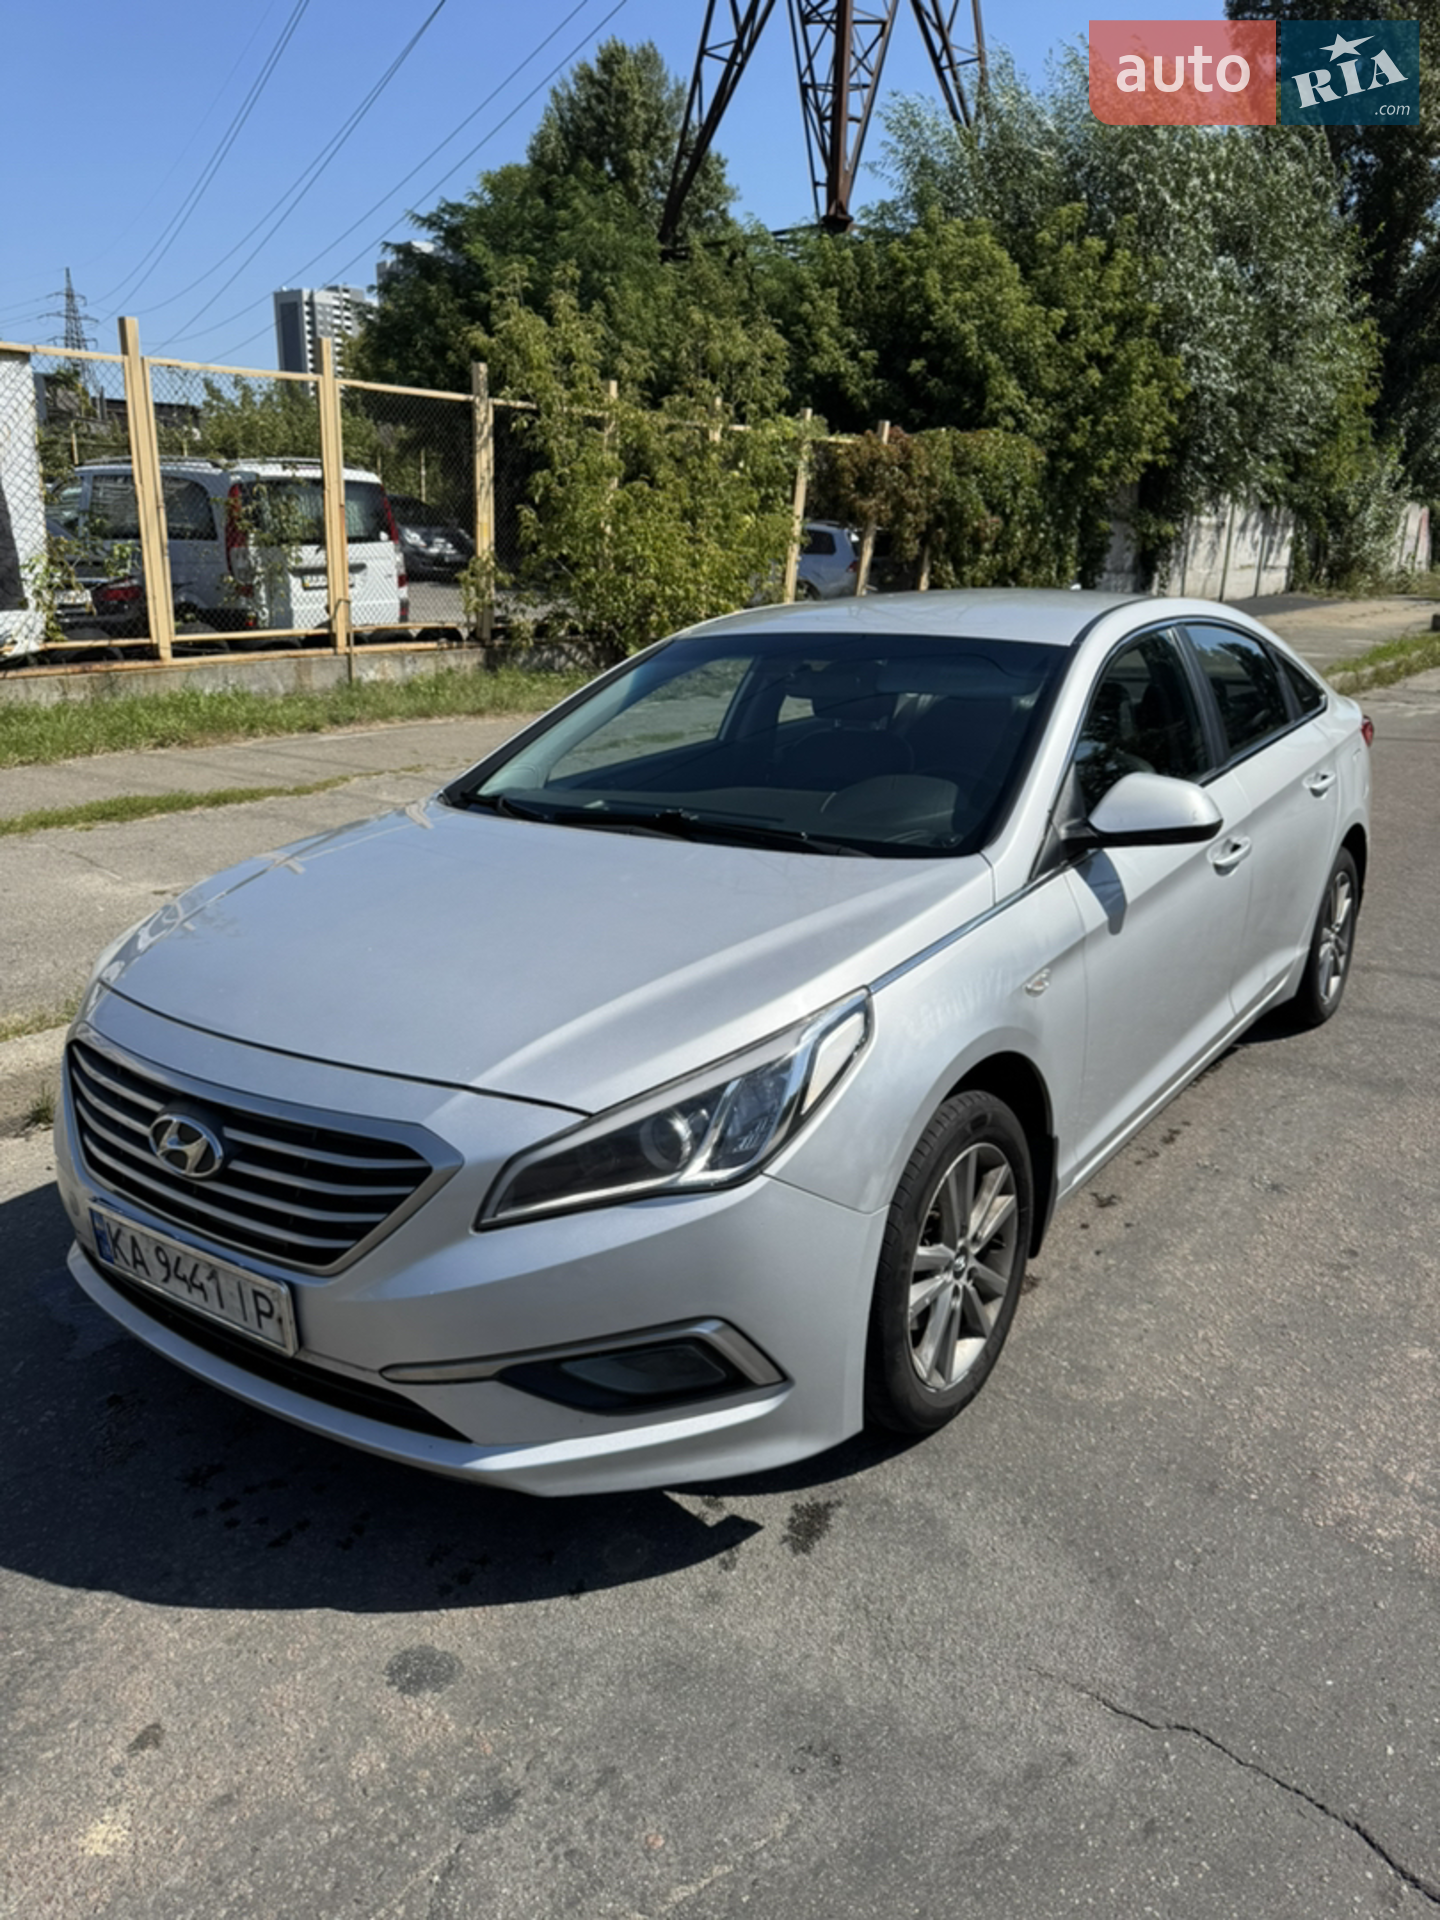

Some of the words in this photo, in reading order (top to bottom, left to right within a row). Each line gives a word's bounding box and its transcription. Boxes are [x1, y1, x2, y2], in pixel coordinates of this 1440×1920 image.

[106, 1221, 150, 1276] KA
[155, 1246, 225, 1310] 9441
[237, 1280, 275, 1330] IP
